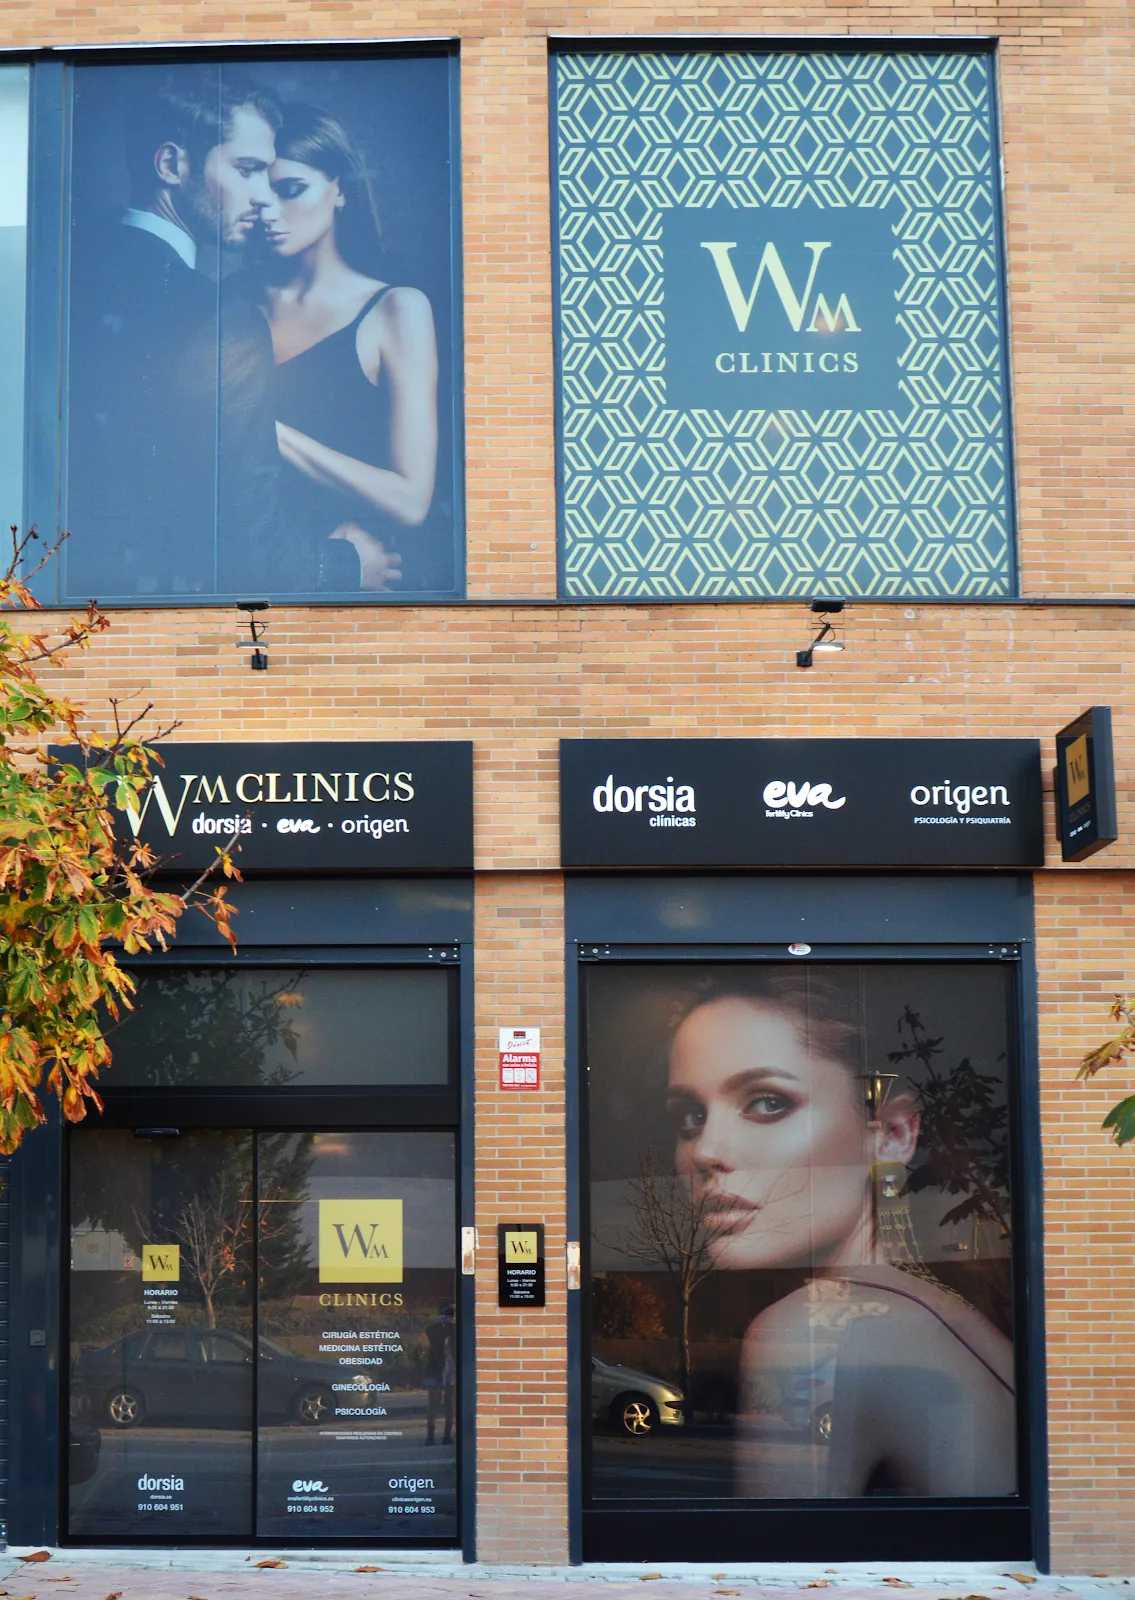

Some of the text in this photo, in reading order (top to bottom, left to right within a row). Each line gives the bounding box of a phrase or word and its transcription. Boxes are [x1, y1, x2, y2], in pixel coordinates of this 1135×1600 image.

[715, 352, 859, 373] CLINICS
[235, 772, 415, 803] CLINICS
[592, 774, 696, 813] dorsia
[763, 780, 846, 809] eva
[910, 779, 1011, 814] origen
[192, 812, 409, 839] dorsia eva origen
[650, 814, 696, 827] clínicas
[914, 816, 958, 824] PSICOLOGÍA
[966, 816, 1011, 824] PSIQUIATRÍA
[502, 1054, 537, 1063] Alarma
[319, 1293, 403, 1306] CLINICS
[322, 1330, 400, 1339] CIRUGÍA ESTÉTICA
[319, 1343, 403, 1352] MEDICINA ESTÉTICA
[339, 1357, 383, 1365] OBESIDAD
[332, 1382, 391, 1391] GINECOLOGÍA
[335, 1406, 387, 1416] PSICOLOGÍA
[138, 1473, 184, 1490] dorsia
[292, 1480, 329, 1492] eva
[388, 1476, 435, 1492] origen
